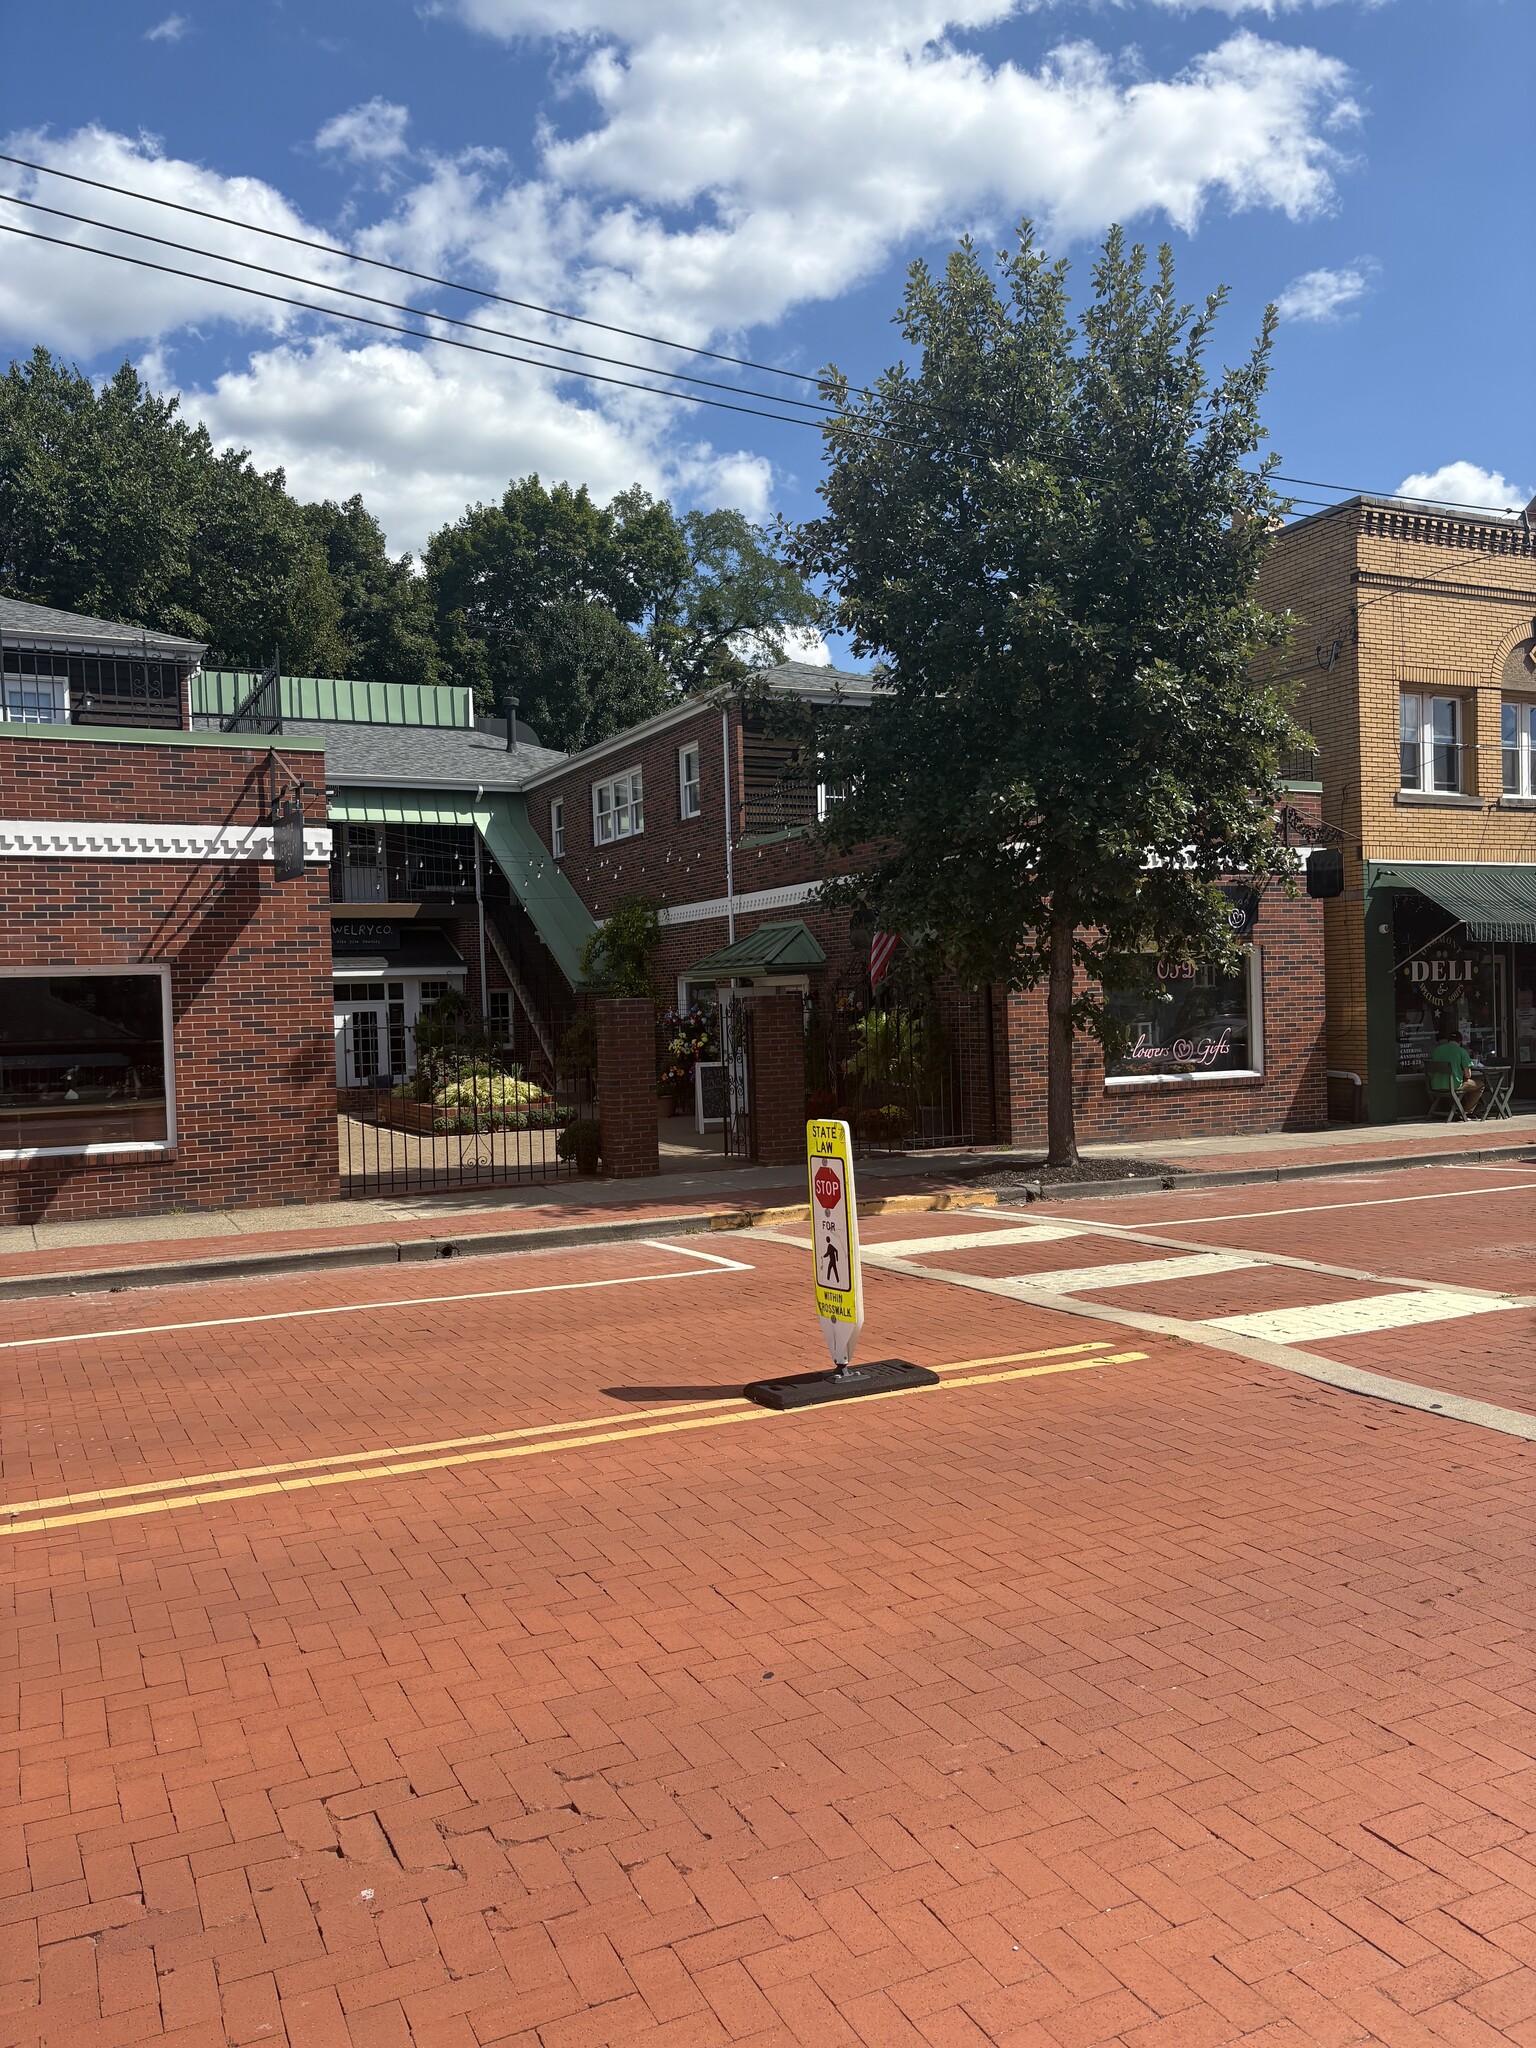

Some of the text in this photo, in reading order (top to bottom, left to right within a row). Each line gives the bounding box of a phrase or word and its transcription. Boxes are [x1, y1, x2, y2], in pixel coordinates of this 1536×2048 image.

[1411, 960, 1473, 982] DELI
[1437, 983, 1449, 995] &
[1131, 1027, 1232, 1066] lowers Gifts
[812, 1126, 837, 1139] STATE
[816, 1141, 833, 1154] LAW
[816, 1180, 839, 1196] STOP
[822, 1221, 836, 1231] FOR
[824, 1292, 843, 1303] WITHIN
